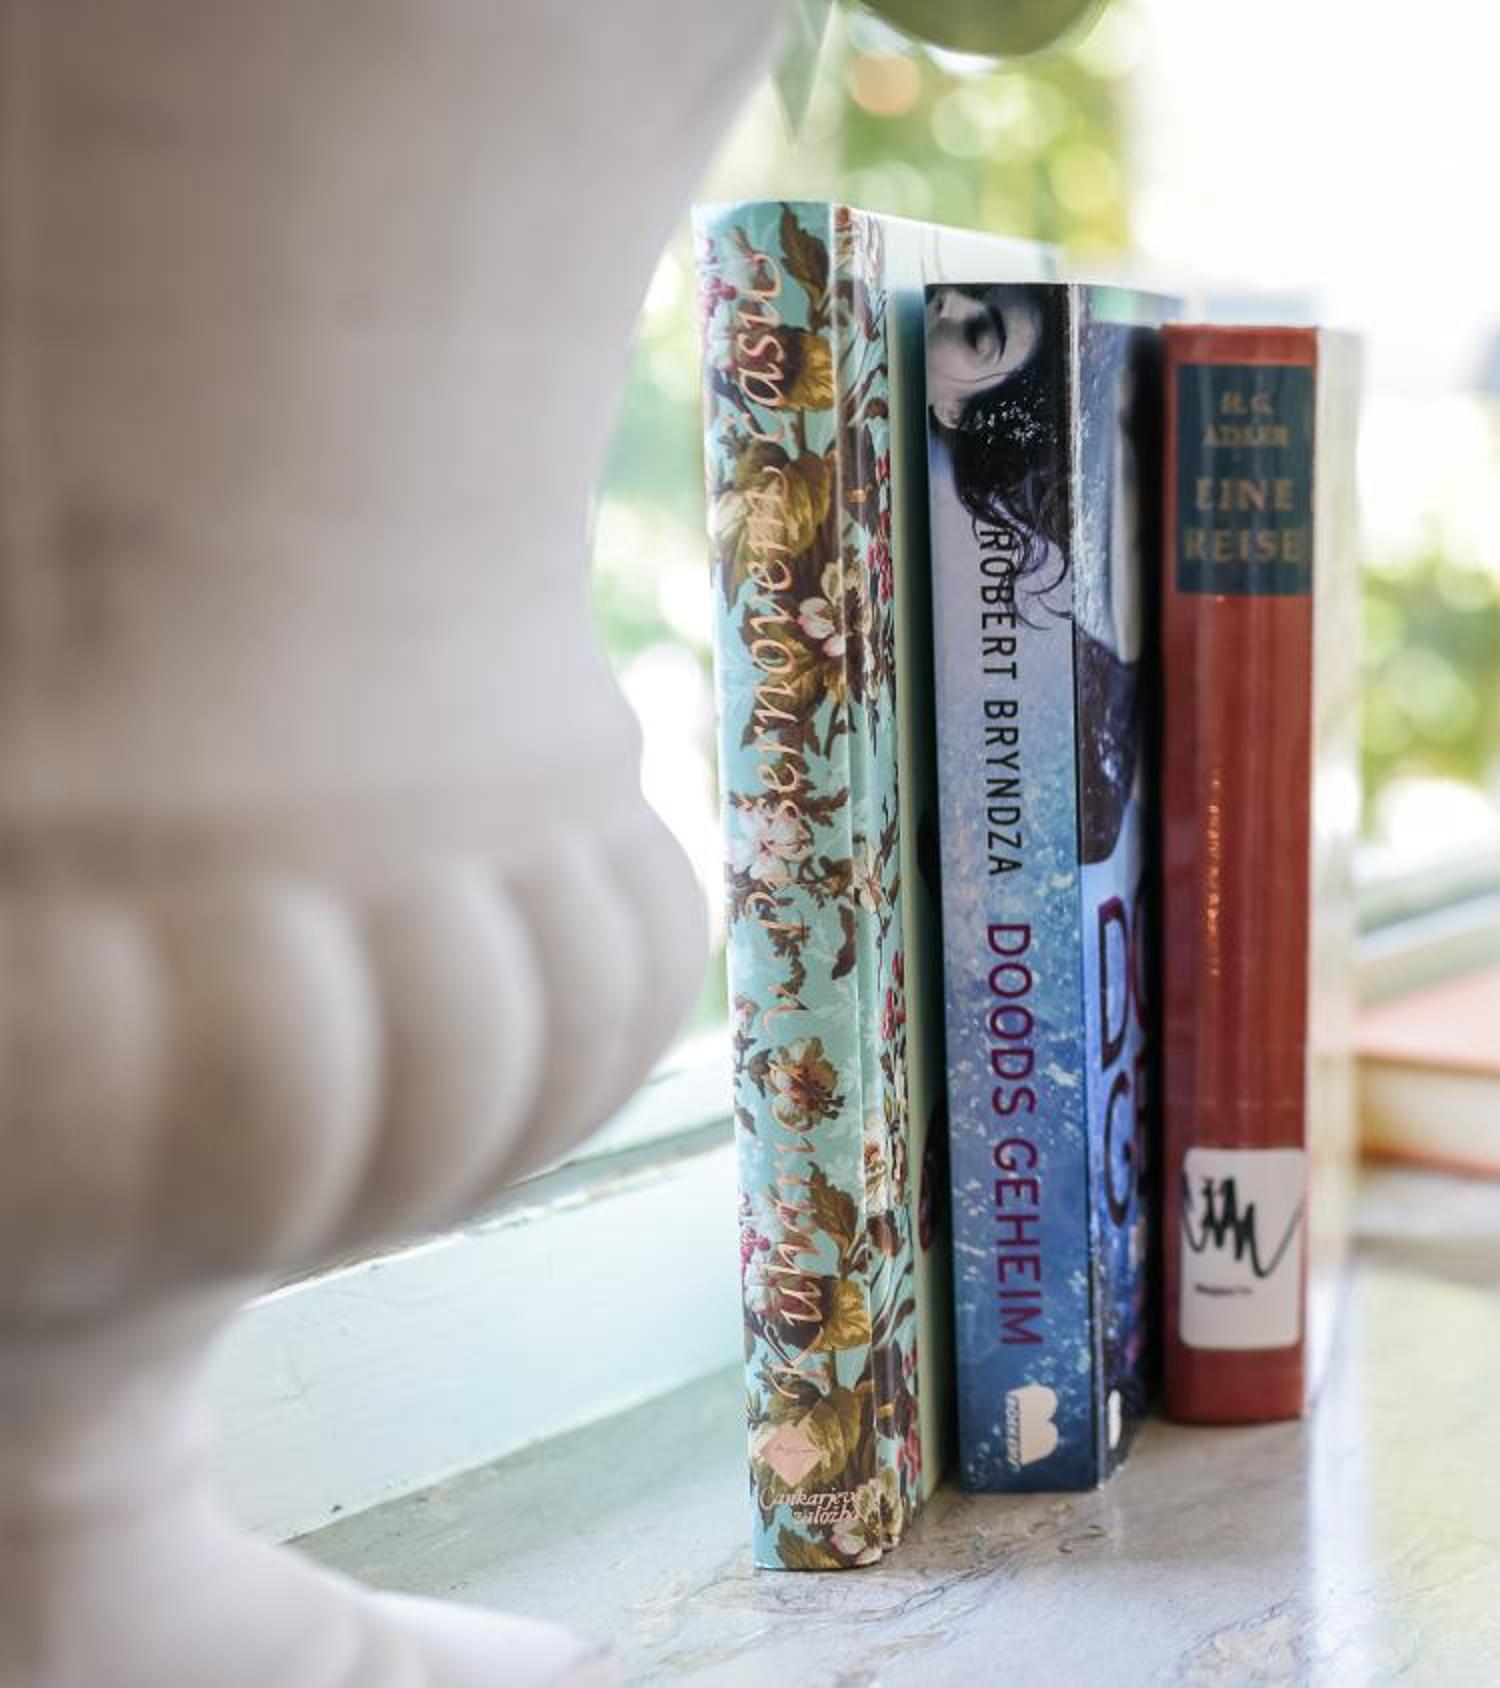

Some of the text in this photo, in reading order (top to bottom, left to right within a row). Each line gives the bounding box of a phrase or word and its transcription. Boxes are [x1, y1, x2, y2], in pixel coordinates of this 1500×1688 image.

[1196, 478, 1294, 512] EINE
[1184, 527, 1301, 563] REISE
[979, 528, 1044, 1346] ROBERT BRYNDZA DOODS GEHEIM
